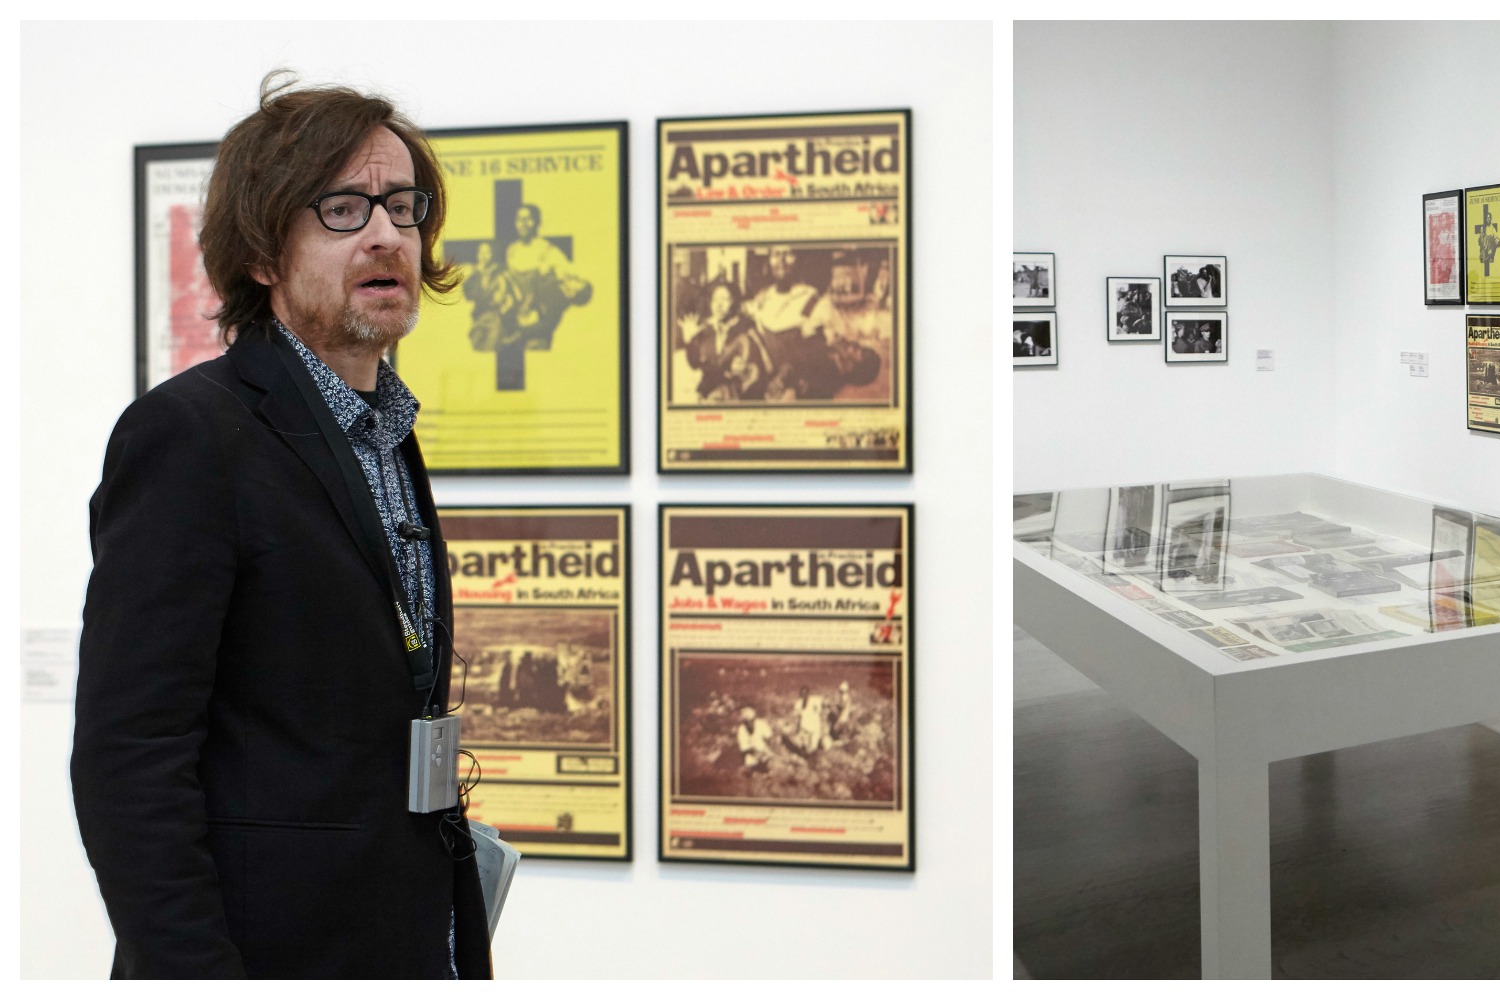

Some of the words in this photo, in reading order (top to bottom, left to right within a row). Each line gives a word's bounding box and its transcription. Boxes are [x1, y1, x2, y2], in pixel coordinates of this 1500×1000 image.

[442, 160, 472, 176] NE
[480, 159, 501, 176] 16
[506, 154, 604, 175] SERVICE
[668, 136, 899, 187] Apartheid
[807, 184, 851, 197] South
[854, 182, 899, 196] Africa
[448, 540, 619, 577] partheid
[670, 551, 902, 595] Apartheid
[517, 589, 529, 600] in
[533, 588, 573, 600] South
[576, 588, 619, 600] Africa
[669, 597, 704, 610] Jobs
[707, 596, 717, 609] &
[720, 597, 768, 613] Wages
[771, 599, 784, 610] in
[787, 599, 832, 611] South
[835, 598, 880, 611] Africa
